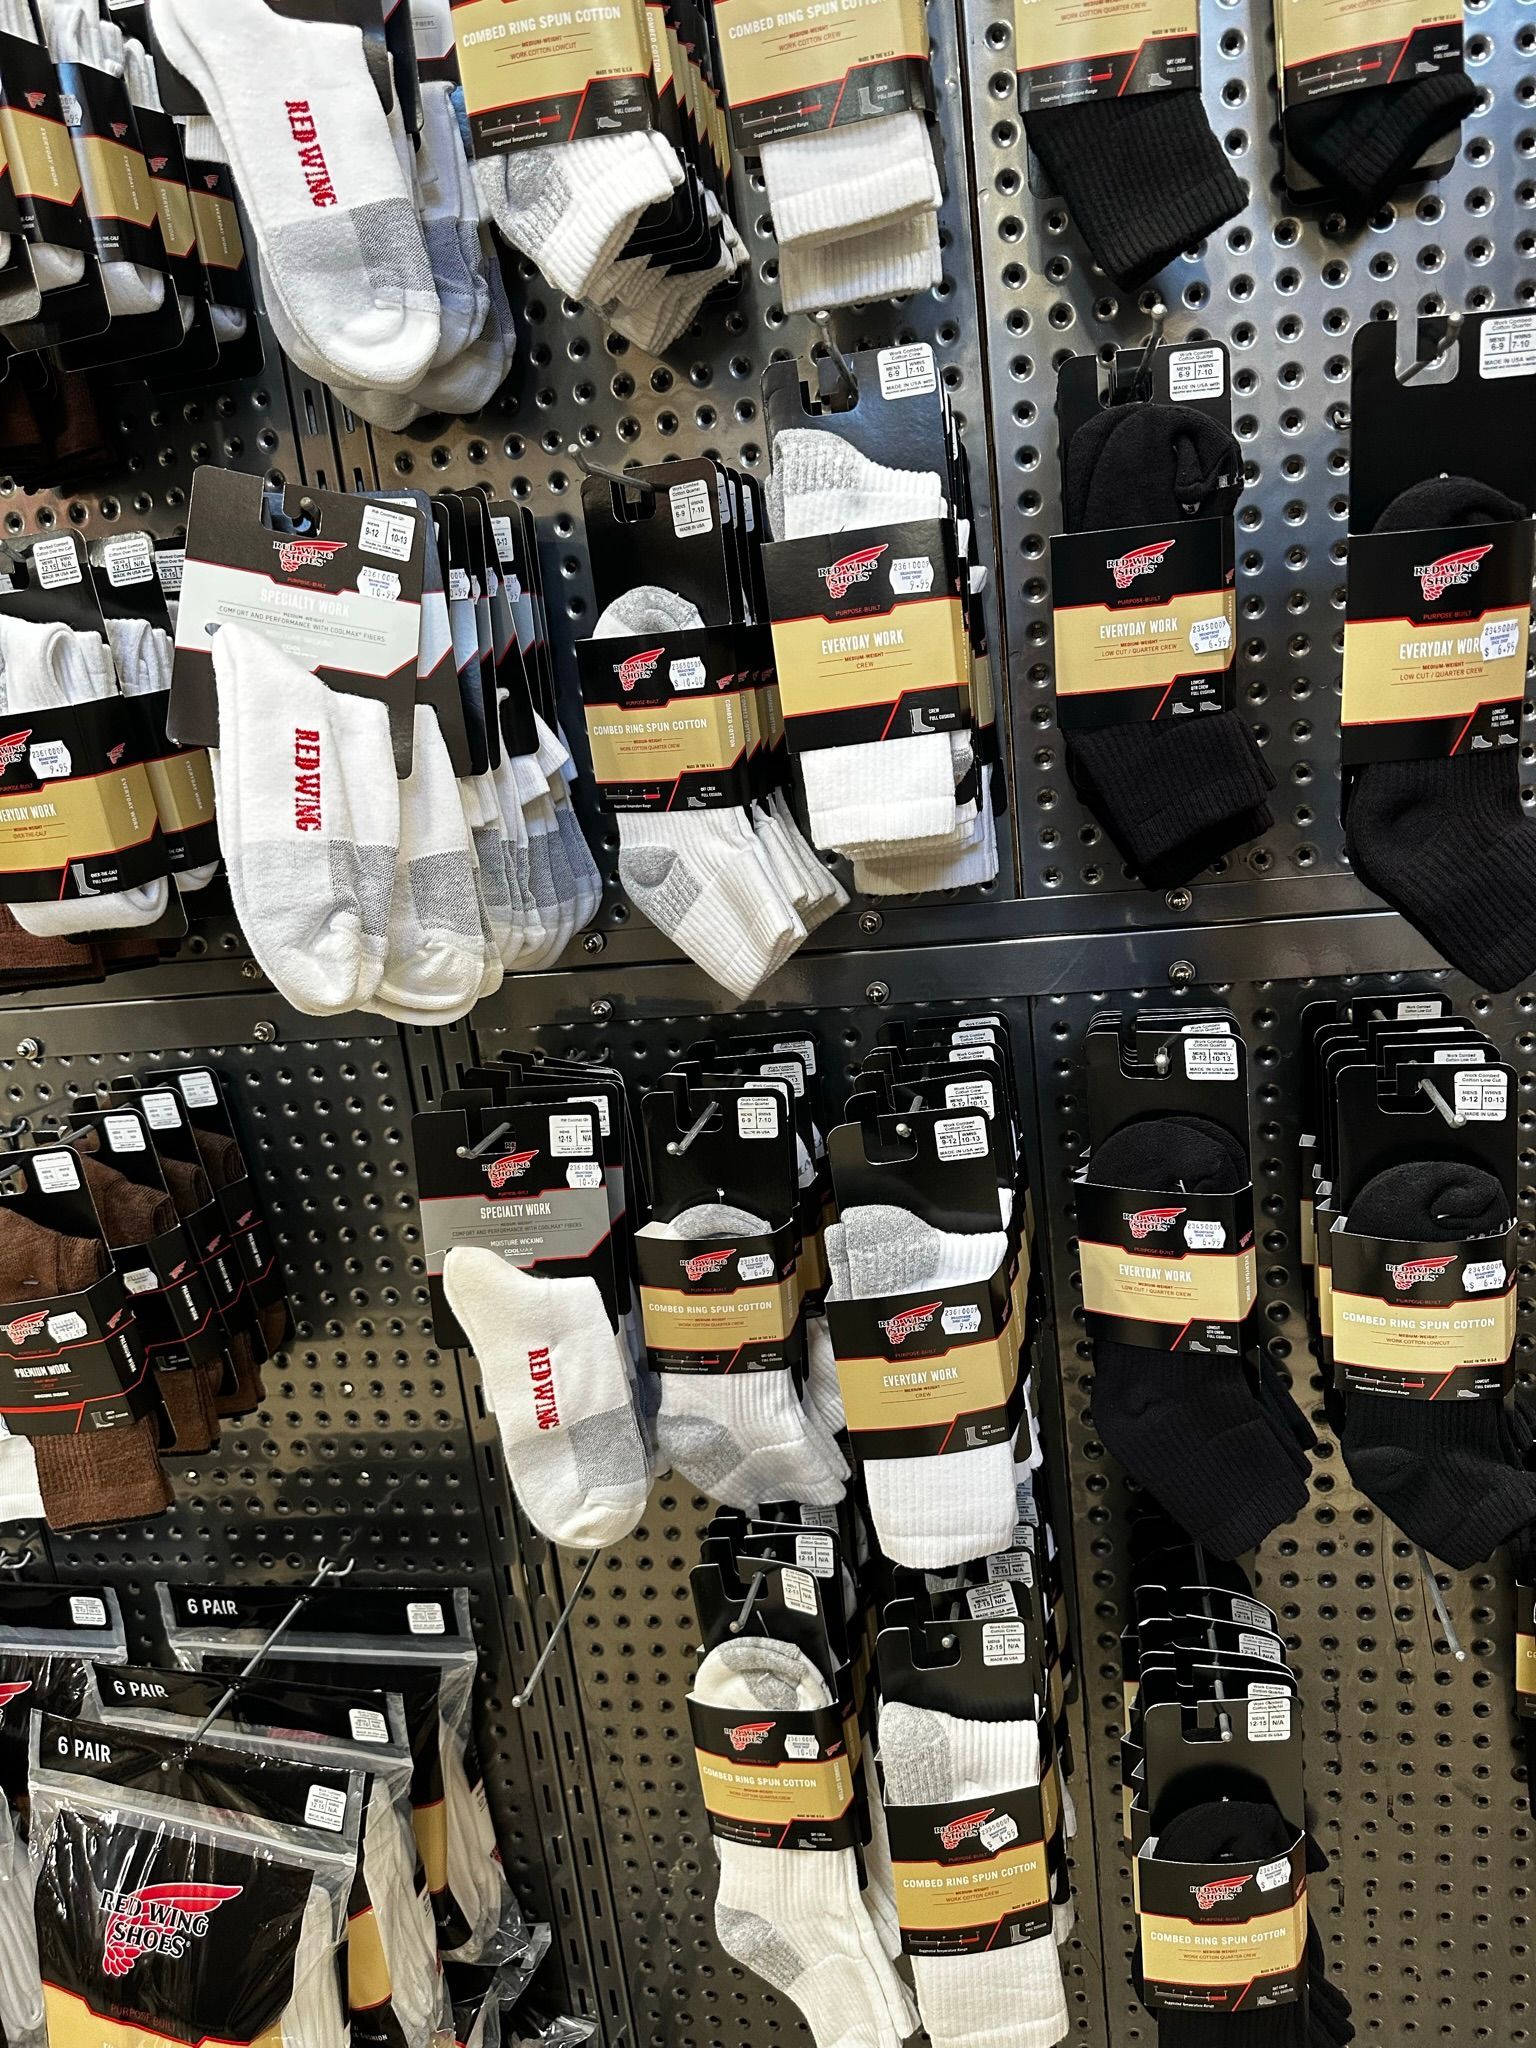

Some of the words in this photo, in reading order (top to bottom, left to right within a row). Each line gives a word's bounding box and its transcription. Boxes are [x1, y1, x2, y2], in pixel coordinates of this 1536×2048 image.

[729, 18, 774, 39] COMBED
[777, 10, 804, 27] RING
[807, 2, 838, 19] SPUN
[1079, 9, 1102, 18] COTTON
[463, 27, 505, 47] COMBED
[510, 19, 536, 35] RING
[539, 12, 573, 28] SPUN
[575, 6, 621, 22] COTTON
[647, 12, 657, 42] COMBED
[652, 44, 661, 73] COTTON
[779, 42, 796, 51] WORK
[798, 36, 822, 47] COTTON
[824, 31, 841, 41] CREW
[510, 50, 527, 60] WORK
[528, 47, 551, 56] COTTON
[552, 42, 577, 52] LOWCUT
[285, 101, 317, 143] RED
[298, 144, 338, 207] WING
[909, 366, 924, 374] 7-10
[365, 527, 379, 537] 9-12
[391, 534, 407, 544] 10-13
[284, 553, 324, 566] SHOES
[1107, 559, 1129, 569] RED
[1130, 555, 1163, 565] WING
[818, 565, 841, 577] RED
[842, 560, 878, 574] WING
[1118, 565, 1154, 575] SHOES
[1414, 565, 1439, 576] RED
[1440, 561, 1479, 573] WING
[830, 572, 870, 586] SHOES
[910, 581, 930, 591] 9.95
[1427, 575, 1468, 586] SHOES
[372, 588, 395, 600] 10.95
[260, 589, 316, 613] SPECIALTY
[318, 601, 350, 617] WORK
[219, 606, 248, 617] COMFORT
[251, 612, 264, 620] AND
[265, 614, 310, 629] PERFORMANCE
[313, 623, 329, 632] WITH
[363, 632, 385, 643] FIBERS
[1100, 621, 1146, 639] EVERYDAY
[1150, 618, 1177, 633] WORK
[821, 634, 869, 655] EVERYDAY
[874, 629, 904, 647] WORK
[1120, 639, 1158, 647] MEDIUM-WEIGHT
[1209, 638, 1226, 649] 6.95
[1400, 640, 1452, 659] EVERYDAY
[1457, 638, 1482, 656] WOR
[1498, 642, 1515, 656] 6.95
[844, 652, 884, 662] MEDIUM-WEIGHT
[1133, 646, 1159, 654] QUARTER
[856, 661, 874, 669] CREW
[1422, 661, 1464, 670] MEDIUM-WEIGHT
[1400, 673, 1415, 681] LOW
[1435, 669, 1464, 678] QUARTER
[1466, 667, 1483, 675] CREW
[683, 676, 703, 687] 10.00
[593, 725, 623, 736] COMBED
[626, 723, 644, 734] RING
[647, 721, 669, 732] SPUN
[672, 718, 707, 731] COTTON
[295, 728, 320, 770] RED
[50, 762, 68, 774] 9.95
[295, 773, 321, 831] WING
[32, 803, 57, 819] WORK
[558, 1135, 573, 1143] 12-15
[961, 1135, 981, 1143] 10-13
[579, 1178, 599, 1186] 10.95
[480, 1205, 523, 1219] SPECIALTY
[527, 1202, 551, 1215] WORK
[452, 1229, 475, 1237] COMFORT
[488, 1227, 523, 1235] PERFORMANCE
[1134, 1222, 1168, 1231] SHOES
[491, 1238, 519, 1247] MOISTURE
[520, 1237, 543, 1245] WICKING
[1202, 1238, 1221, 1247] 6.95
[1119, 1264, 1161, 1280] EVERYDAY
[1165, 1270, 1192, 1282] WORK
[1397, 1273, 1436, 1282] SHOES
[1483, 1278, 1502, 1287] 6.95
[1149, 1288, 1174, 1296] QUARTER
[649, 1303, 684, 1314] COMBED
[687, 1305, 707, 1314] RING
[711, 1305, 735, 1313] SPUN
[738, 1301, 772, 1311] COTTON
[903, 1315, 933, 1326] WING
[960, 1323, 977, 1331] 9.95
[1342, 1312, 1386, 1326] COMBED
[1390, 1318, 1416, 1329] RING
[1419, 1319, 1449, 1329] SPUN
[1453, 1317, 1495, 1329] COTTON
[889, 1324, 926, 1335] SHOES
[14, 1366, 48, 1378] PREMIUM
[47, 1363, 71, 1375] WORK
[528, 1347, 551, 1381] RED
[883, 1372, 927, 1388] EVERYDAY
[931, 1367, 958, 1382] WORK
[533, 1380, 560, 1430] WING
[188, 1598, 198, 1614] 6
[202, 1599, 238, 1616] PAIR
[113, 1680, 125, 1696] 6
[130, 1681, 169, 1699] PAIR
[57, 1736, 68, 1755] 6
[74, 1739, 112, 1764] PAIR
[703, 1766, 733, 1782] COMBED
[735, 1772, 754, 1785] RING
[757, 1775, 780, 1786] SPUN
[783, 1778, 817, 1788] COTTON
[903, 1878, 943, 1888] COMBED
[946, 1875, 969, 1886] RING
[972, 1871, 998, 1884] SPUN
[1001, 1861, 1037, 1877] COTTON
[962, 1893, 983, 1901] COTTON
[99, 1889, 142, 1918] RED
[149, 1902, 209, 1937] WING
[112, 1921, 185, 1958] SHOES
[1150, 1931, 1191, 1944] COMBED
[1195, 1935, 1218, 1945] RING
[1221, 1935, 1247, 1945] SPUN
[1251, 1927, 1286, 1943] COTTON
